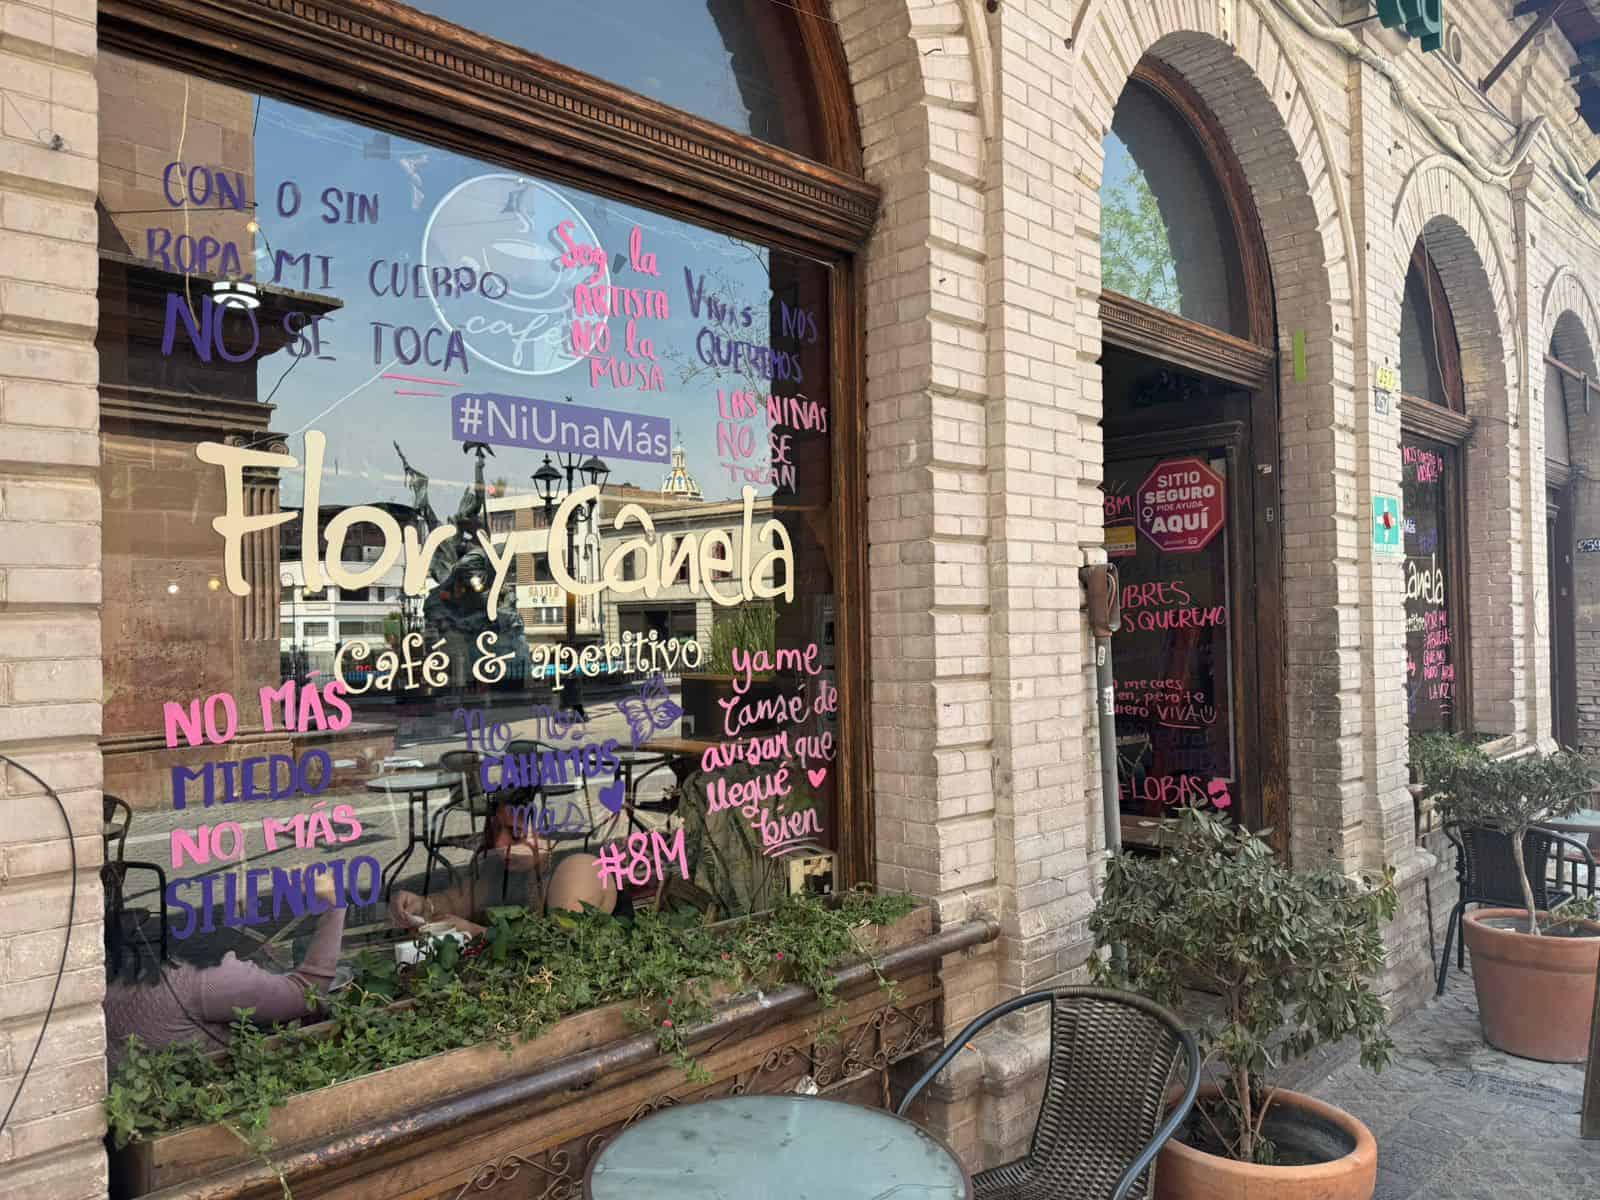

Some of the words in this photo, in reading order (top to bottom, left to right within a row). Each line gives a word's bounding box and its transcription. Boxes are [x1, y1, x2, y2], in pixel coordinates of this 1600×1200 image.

[163, 161, 246, 210] CON
[277, 181, 301, 218] O
[321, 187, 379, 224] SIN
[274, 249, 336, 289] MI
[369, 257, 509, 300] CUERPO
[556, 219, 608, 285] Soy
[630, 225, 662, 277] la
[574, 282, 670, 321] ARTISTA
[779, 300, 818, 344] NOS
[161, 292, 260, 363] NO
[282, 310, 336, 361] SE
[369, 321, 469, 374] TOCA
[572, 319, 611, 356] NO
[626, 319, 659, 360] la
[697, 326, 804, 384] QUEREMOS
[590, 356, 666, 392] MUSA
[459, 398, 670, 457] #NiUnaMás
[717, 387, 758, 421] LAS
[766, 393, 828, 433] NIÑAS
[717, 422, 757, 461] NO
[768, 433, 792, 464] SE
[721, 462, 797, 494] TOCAN
[1144, 484, 1216, 505] SEGURO
[1157, 471, 1200, 489] SITIO
[196, 430, 458, 598] Flor
[477, 528, 518, 622] y
[548, 484, 795, 607] Canela
[1151, 507, 1209, 534] AQUÍ
[1120, 580, 1191, 610] IBRES
[1403, 552, 1444, 606] anela
[1137, 606, 1226, 632] QUEREMO
[333, 632, 451, 695] Café
[472, 631, 516, 683] &
[531, 629, 703, 692] aperitivo
[163, 692, 238, 748] NO
[259, 670, 352, 733] MÁS
[815, 680, 838, 714] de
[702, 731, 793, 773] avisar
[796, 730, 837, 769] que
[171, 749, 332, 810] MIEDO
[706, 761, 792, 818] llegué
[170, 821, 244, 870] NO
[262, 801, 362, 851] MÁS
[751, 804, 824, 846] bien
[592, 826, 690, 890] #8M
[166, 855, 382, 940] SILENCIO
